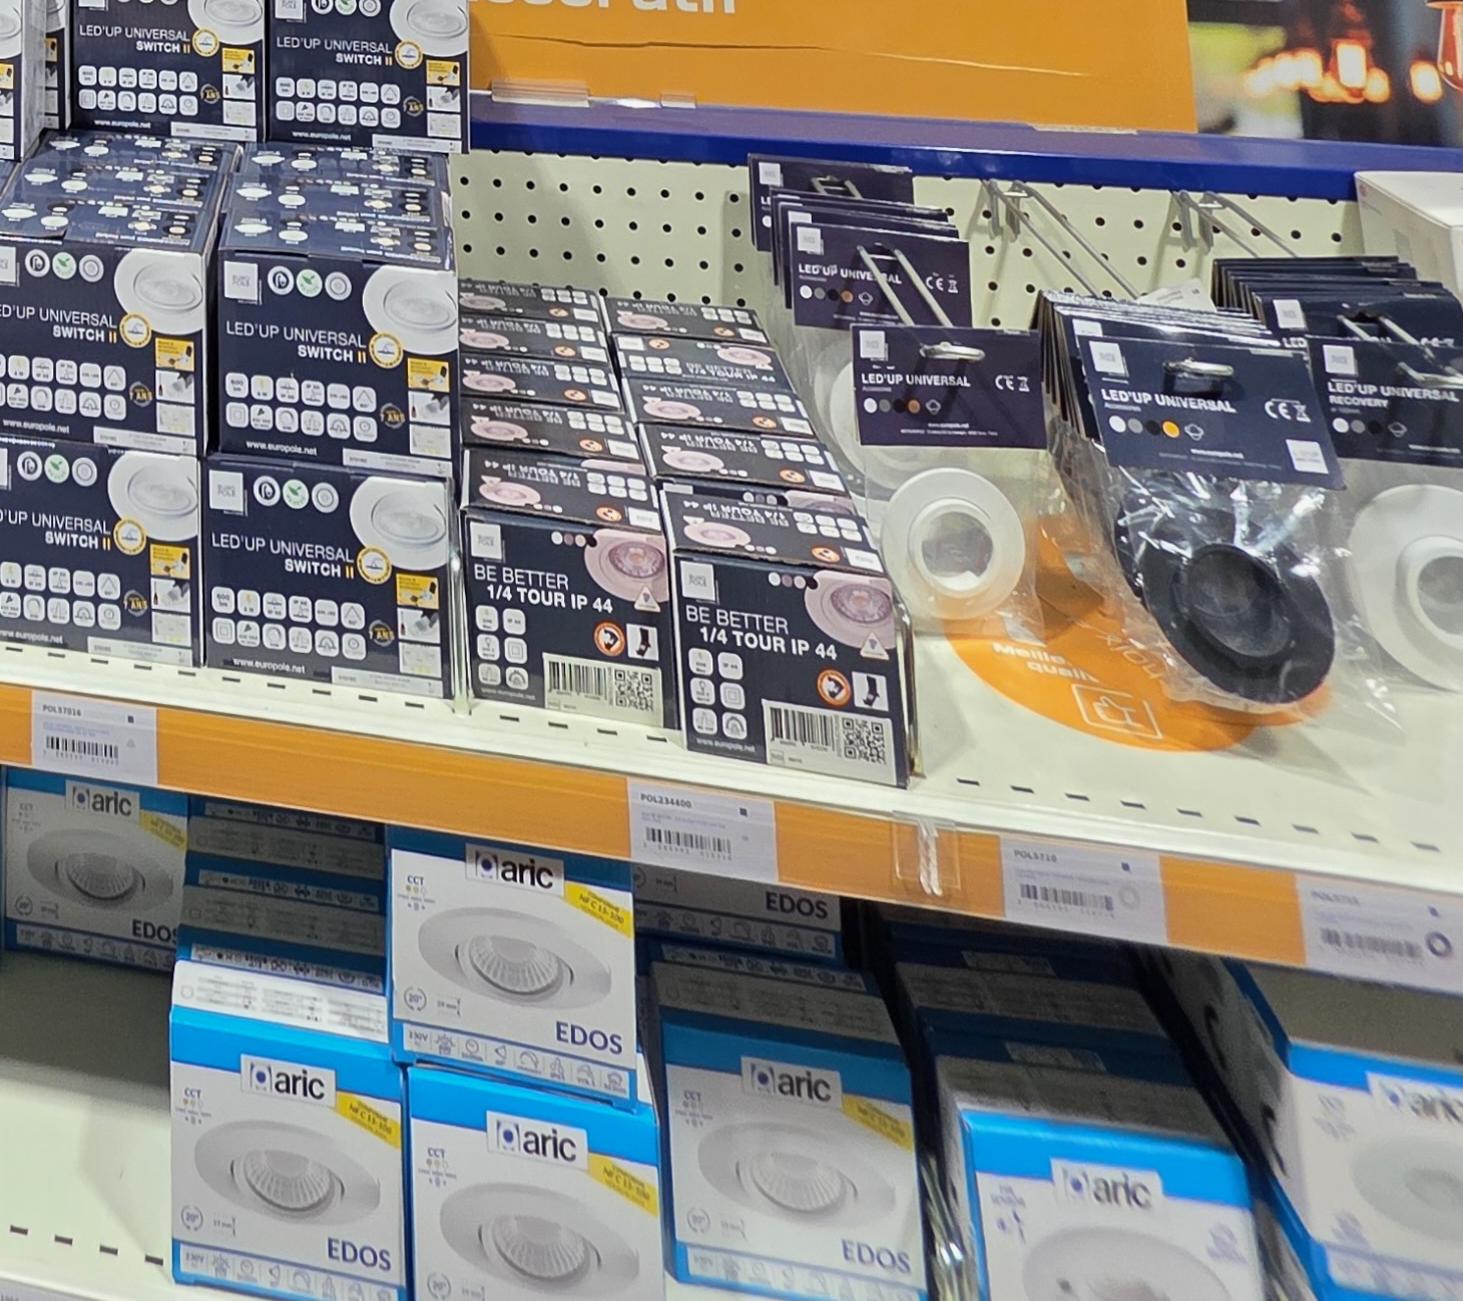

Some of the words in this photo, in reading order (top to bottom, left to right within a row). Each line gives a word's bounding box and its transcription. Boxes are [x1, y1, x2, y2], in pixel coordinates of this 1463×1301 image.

[79, 25, 122, 39] LED'UP
[125, 27, 191, 43] UNIVERSAL
[277, 35, 321, 50] LED'UP
[324, 38, 393, 54] UNIVERSAL
[136, 40, 181, 54] SWITCH
[336, 52, 383, 66] SWITCH
[39, 307, 117, 329] UNIVERSAL
[53, 325, 106, 342] SWITCH
[226, 320, 280, 340] LED'UP
[283, 327, 367, 349] UNIVERSAL
[298, 344, 354, 363] SWITCH
[861, 372, 904, 386] LED'UP
[906, 373, 971, 388] UNIVERSAL
[1102, 388, 1152, 406] LED'UP
[1154, 392, 1237, 414] UNIVERSAL
[1328, 381, 1378, 398] LED'UP
[1380, 385, 1460, 403] UNIVERSAL
[1329, 394, 1389, 410] RECOVERY
[246, 439, 318, 456] www.europole.net
[31, 512, 111, 535] UNIVERSAL
[45, 531, 99, 550] SWITCH
[212, 532, 266, 552] LED'UP
[269, 538, 354, 563] UNIVERSAL
[285, 558, 342, 578] SWITCH
[474, 563, 497, 581] BE
[502, 566, 570, 591] BETTER
[486, 584, 513, 601] 1/4
[517, 587, 566, 608] TOUR
[571, 593, 588, 610] IP
[592, 596, 614, 614] 44
[686, 604, 712, 624] BE
[717, 608, 789, 635] BETTER
[700, 625, 729, 646] 1/4
[734, 630, 786, 654] TOUR
[791, 639, 810, 657] IP
[815, 642, 838, 661] 44
[234, 657, 306, 675] www.europole.net
[92, 787, 132, 817] aric
[407, 874, 425, 887] CCT
[501, 858, 554, 890] aric
[765, 889, 829, 920] EDOS
[556, 1020, 623, 1055] EDOS
[184, 1087, 202, 1099] CCT
[275, 1069, 325, 1100] aric
[778, 1069, 832, 1103] aric
[427, 1147, 446, 1160] CCT
[523, 1127, 577, 1163] aric
[327, 1237, 392, 1272] EDOS
[841, 1238, 911, 1274] EDOS
